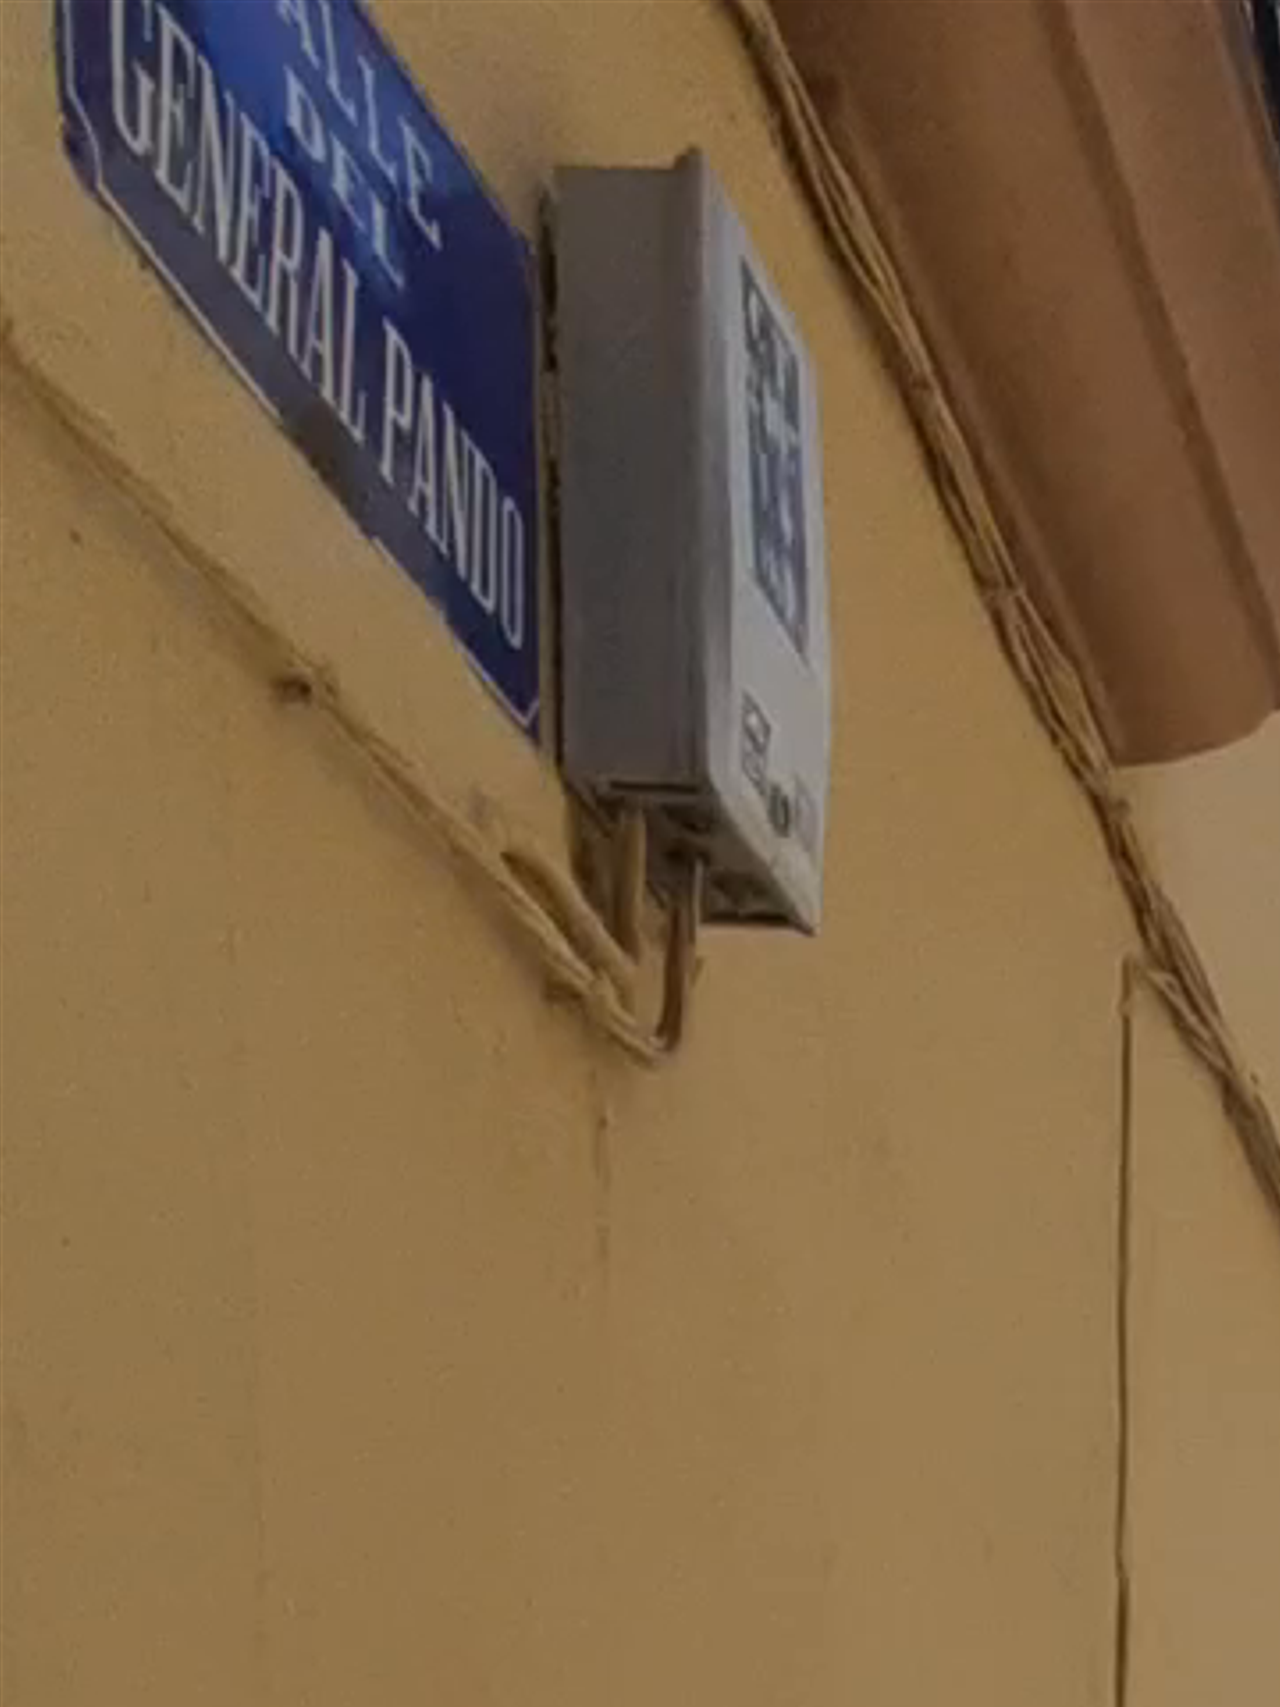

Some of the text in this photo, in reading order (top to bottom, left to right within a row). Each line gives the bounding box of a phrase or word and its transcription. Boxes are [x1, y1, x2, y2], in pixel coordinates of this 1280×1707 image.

[110, 0, 525, 652] GENERAL PANDO
[283, 62, 405, 290] DEL
